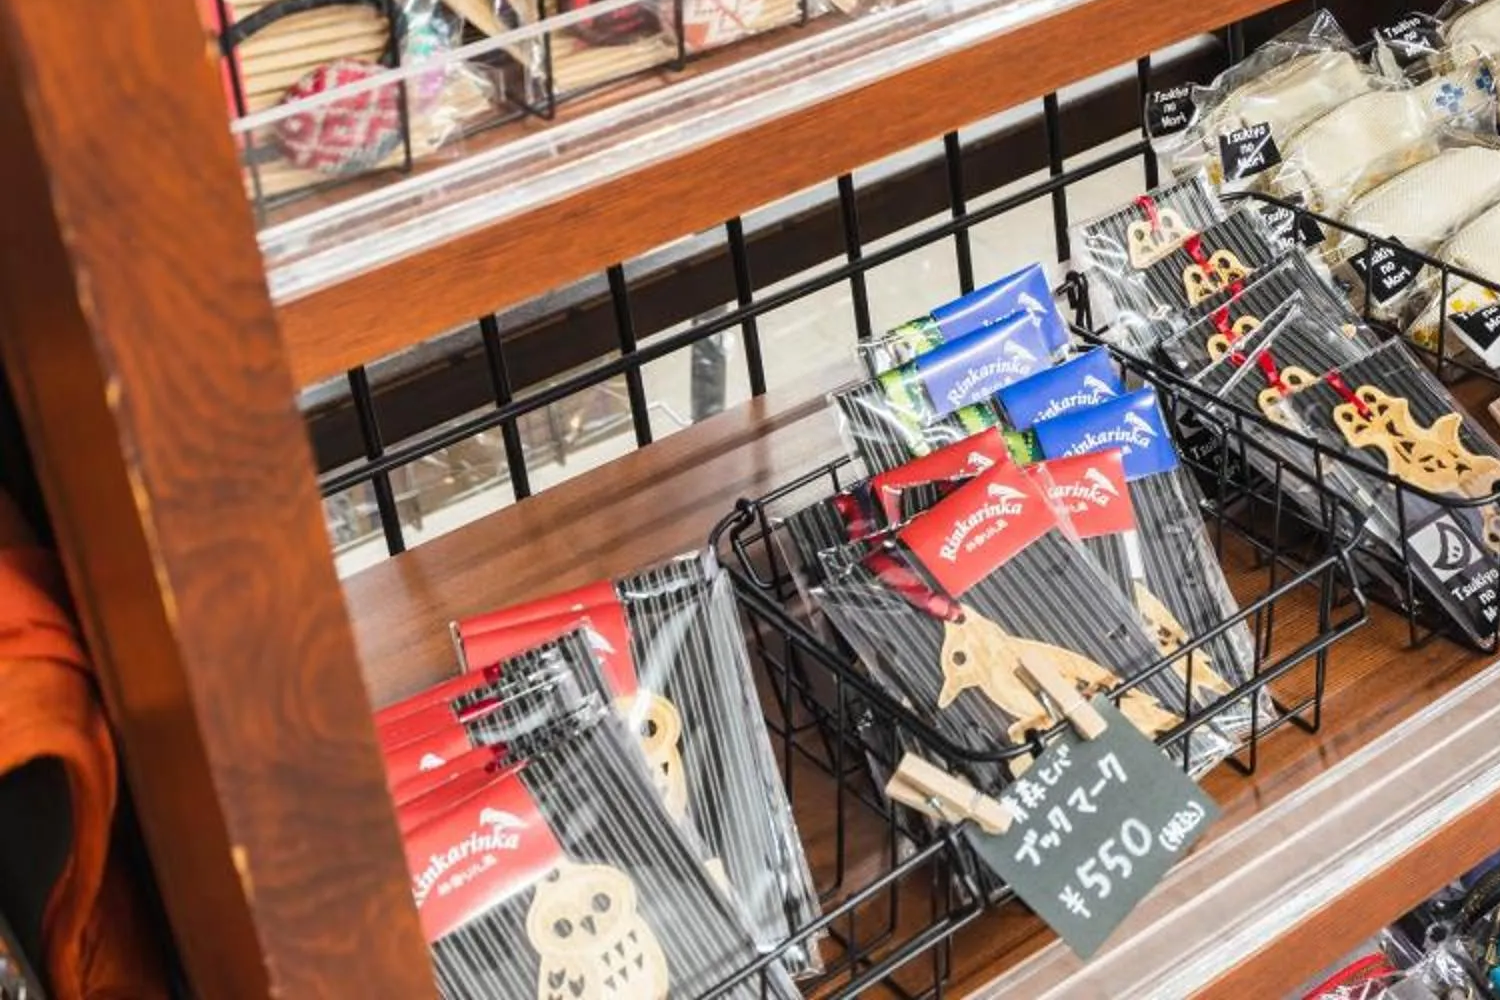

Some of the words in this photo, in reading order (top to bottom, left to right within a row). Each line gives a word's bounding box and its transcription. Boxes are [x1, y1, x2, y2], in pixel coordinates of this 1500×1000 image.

[1379, 260, 1396, 275] no
[1381, 265, 1412, 290] Mori
[946, 356, 1032, 406] Rinkarinka
[939, 500, 1023, 563] Rinkarinka
[1451, 567, 1500, 601] Tsukiyo
[1479, 588, 1497, 605] no
[1015, 751, 1129, 868] ブックマーク
[1058, 816, 1152, 920] ¥550
[1157, 800, 1207, 852] (税込)
